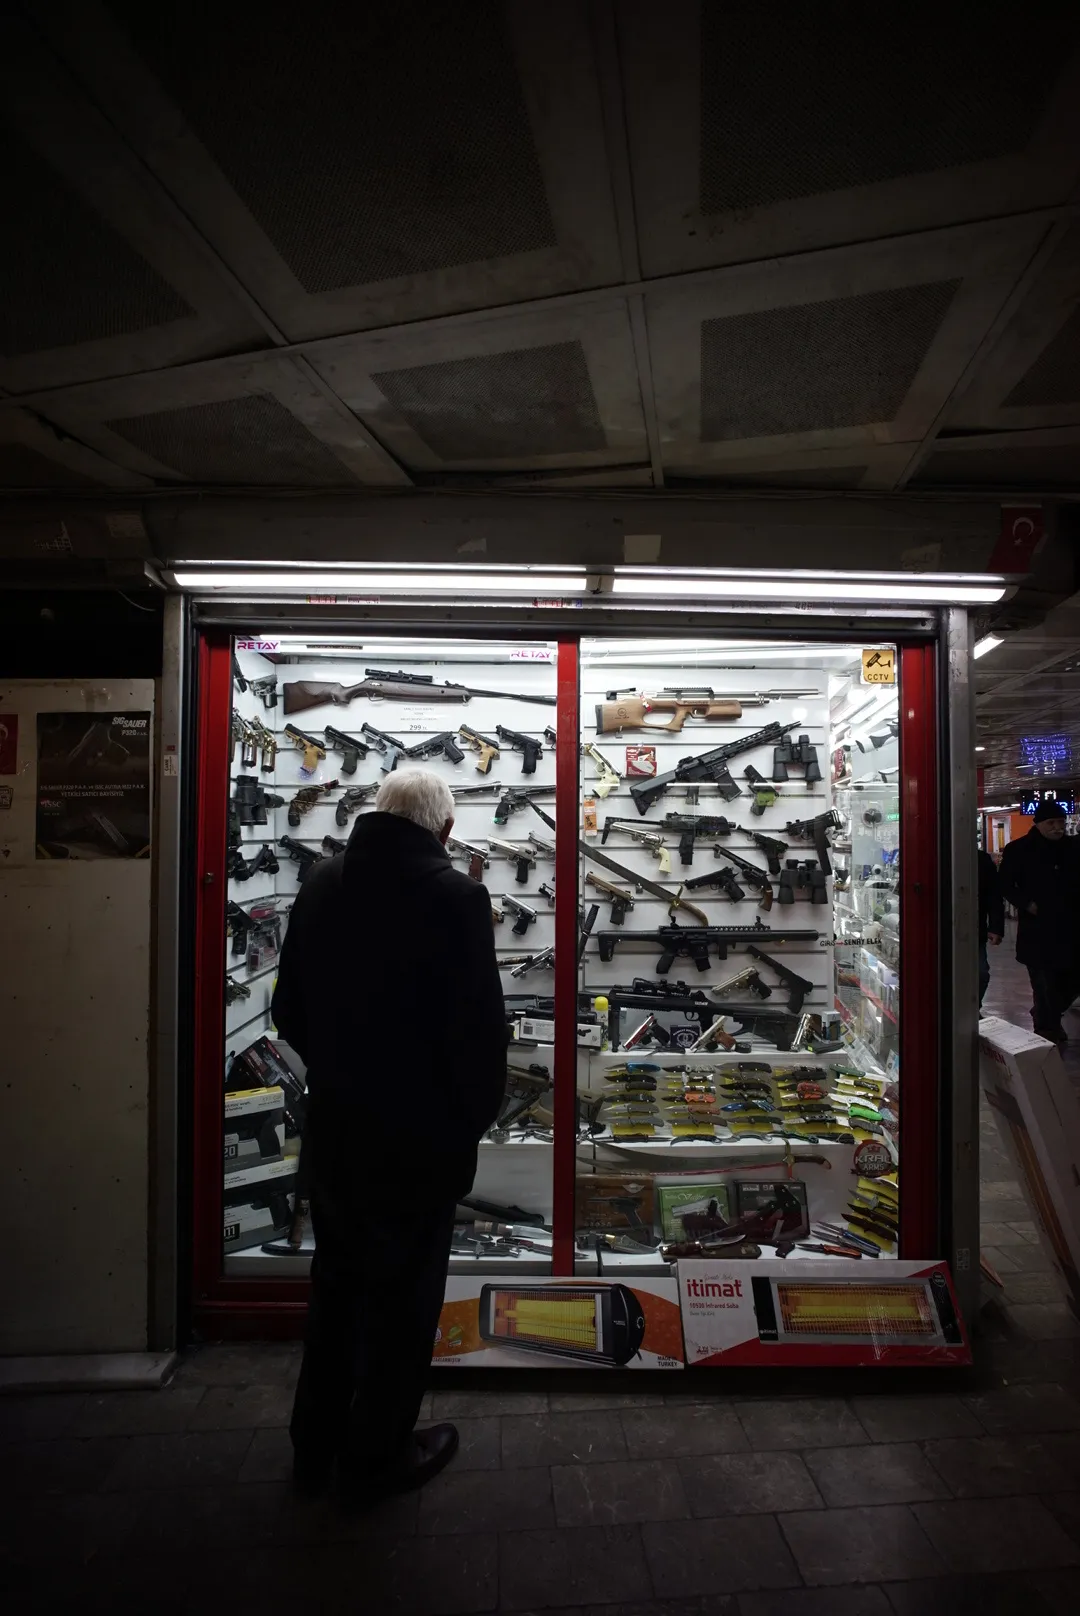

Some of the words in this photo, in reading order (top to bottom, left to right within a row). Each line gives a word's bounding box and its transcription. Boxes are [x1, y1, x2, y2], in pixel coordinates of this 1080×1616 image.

[237, 641, 279, 650] RETAY
[510, 650, 552, 659] RETAY
[867, 673, 889, 681] CCTV
[112, 716, 126, 725] SIG
[122, 719, 148, 728] SAUER
[866, 937, 882, 945] ELEK
[855, 1153, 891, 1164] KRAL
[863, 1163, 885, 1171] ARMS
[686, 1279, 743, 1297] itimat
